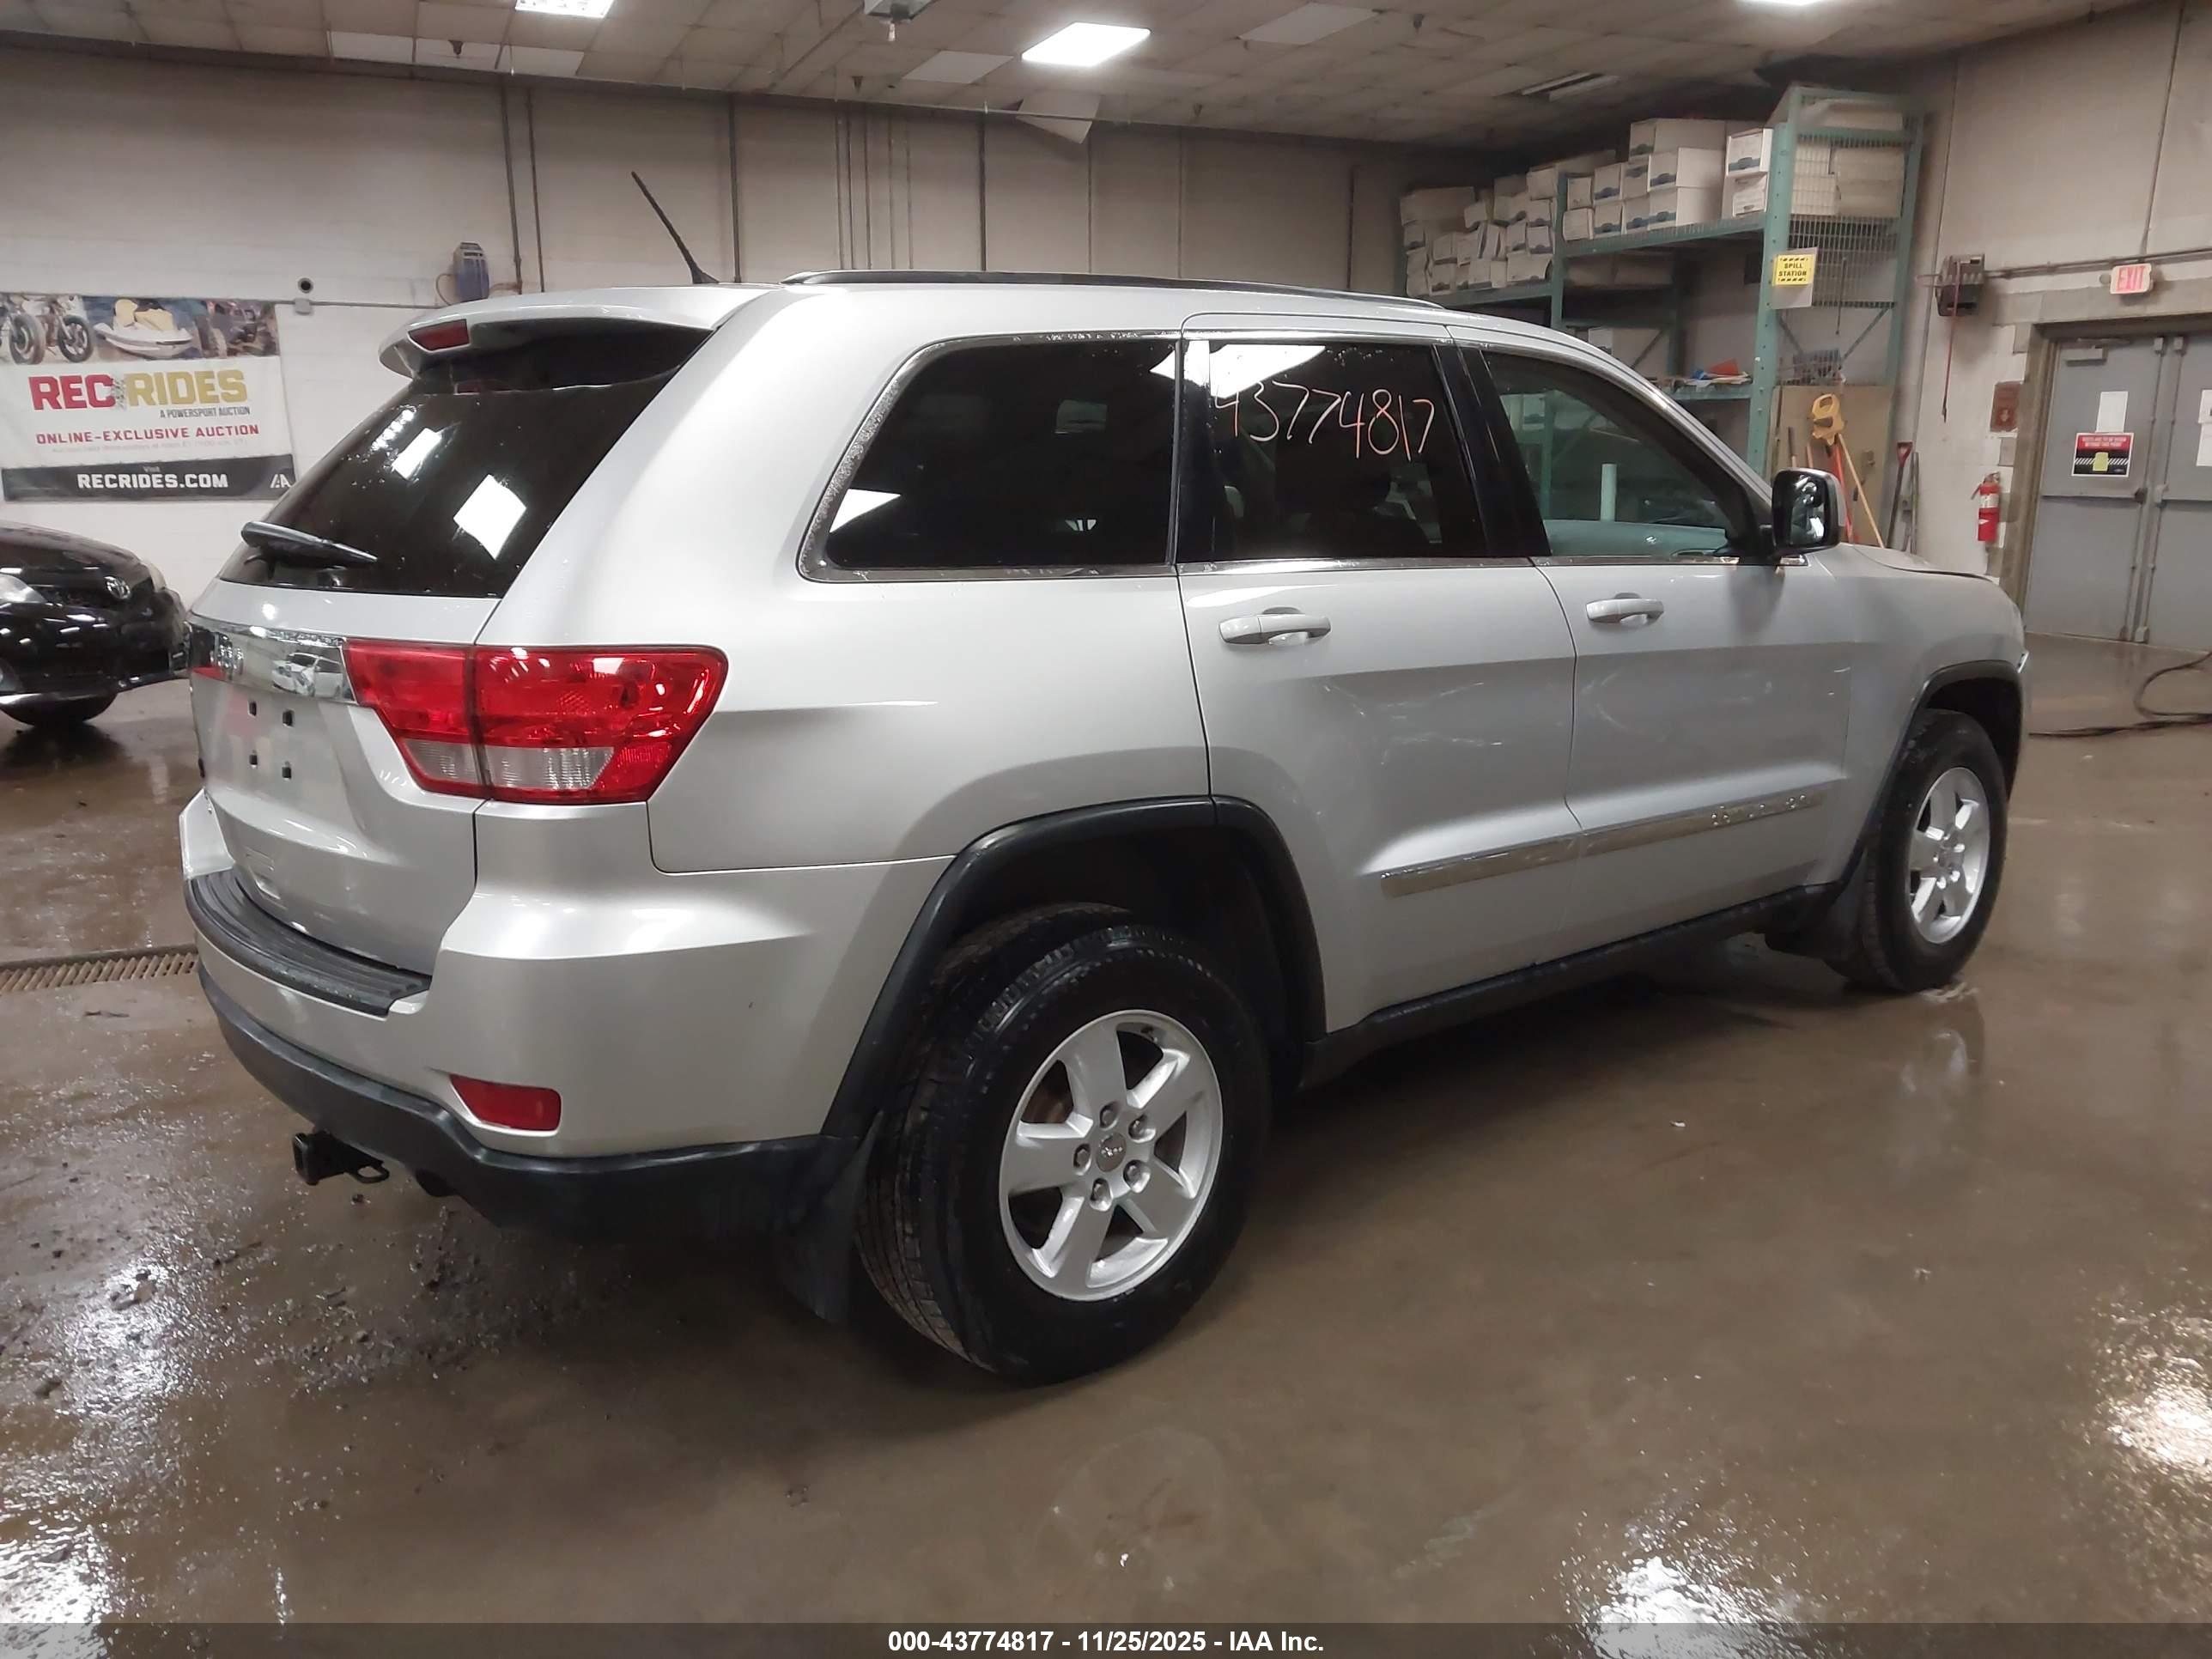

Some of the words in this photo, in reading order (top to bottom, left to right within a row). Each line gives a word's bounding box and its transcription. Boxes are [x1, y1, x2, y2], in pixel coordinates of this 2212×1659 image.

[2117, 265, 2145, 291] EXIT
[28, 374, 117, 410] REC
[124, 369, 248, 406] RIDES
[160, 410, 166, 418] A
[167, 408, 216, 418] POWERSPORT
[219, 406, 251, 416] AUCTION
[1214, 380, 1435, 462] 43774817
[36, 427, 190, 445] ONLINE-EXCLUSIVE
[196, 424, 259, 439] AUCTION
[76, 473, 228, 489] RECRIDES.COM
